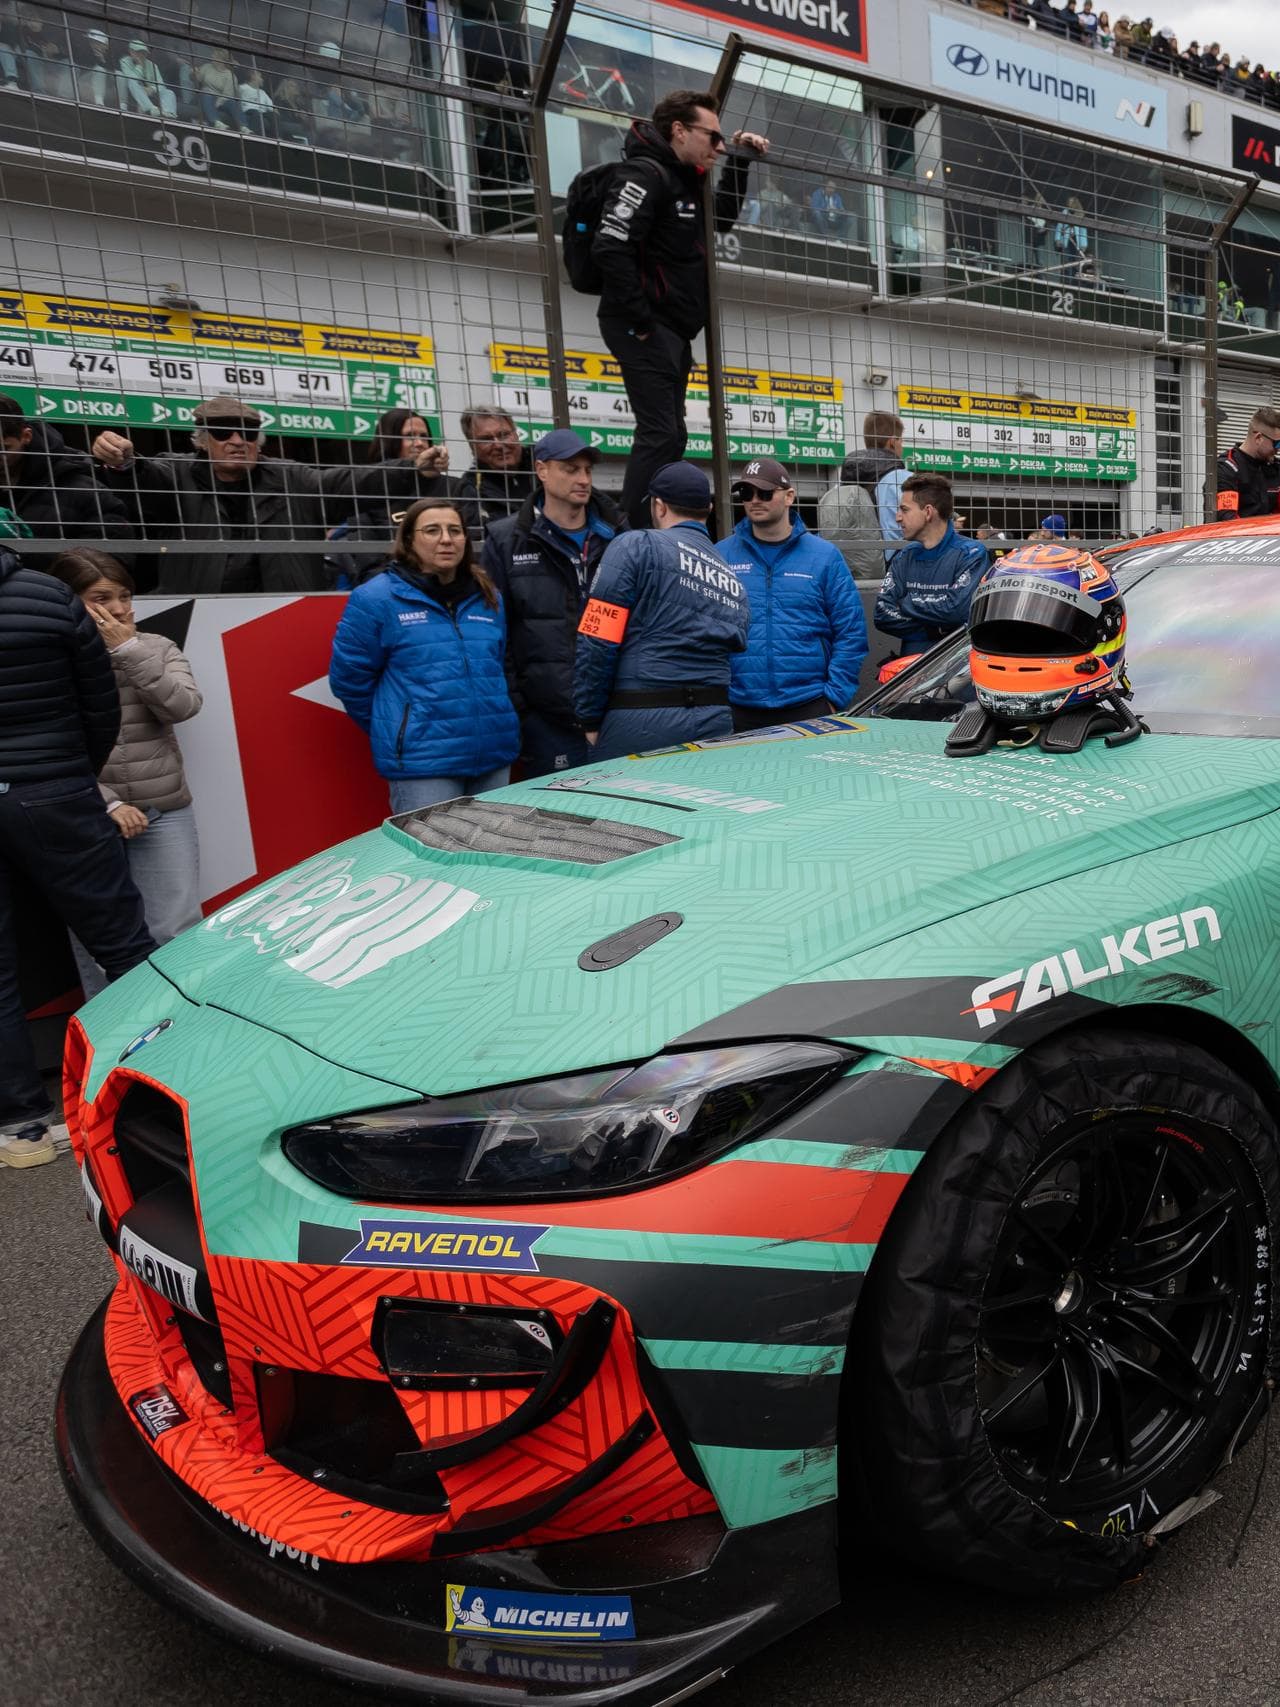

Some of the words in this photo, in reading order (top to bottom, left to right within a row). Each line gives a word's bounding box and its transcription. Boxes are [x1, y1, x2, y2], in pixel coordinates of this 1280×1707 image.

[995, 59, 1096, 108] HYUNDAI
[152, 130, 212, 172] 30
[1051, 290, 1074, 315] 28
[69, 353, 116, 375] 474
[149, 360, 194, 380] 505
[225, 367, 265, 386] 669
[298, 374, 331, 392] 971
[62, 399, 130, 418] DEKRA
[752, 410, 776, 425] 670
[280, 413, 336, 431] DEKRA
[816, 416, 844, 441] 29
[917, 423, 926, 435] 4
[956, 426, 972, 439] 88
[685, 439, 714, 451] EKRA
[741, 441, 777, 455] DEKRA
[801, 445, 836, 459] DEKRA
[1188, 539, 1272, 557] GRAN
[1174, 557, 1201, 566] THE
[1202, 555, 1235, 565] REAL
[678, 552, 741, 598] HAKRO
[1000, 577, 1079, 604] Motorsport
[975, 770, 1024, 784] move
[1024, 780, 1049, 789] or
[1047, 786, 1110, 809] affect
[978, 760, 1071, 783] something
[1072, 780, 1092, 789] is
[1092, 786, 1128, 801] the
[929, 780, 988, 797] ability
[988, 793, 1011, 802] to
[1011, 800, 1038, 812] do
[1038, 808, 1061, 822] it.
[962, 778, 989, 786] do
[988, 783, 1086, 816] something
[962, 905, 1222, 1029] FALKEN
[364, 1230, 522, 1259] RAVENOL
[141, 1393, 180, 1424] DSK
[493, 1605, 630, 1629] MICHELIN
